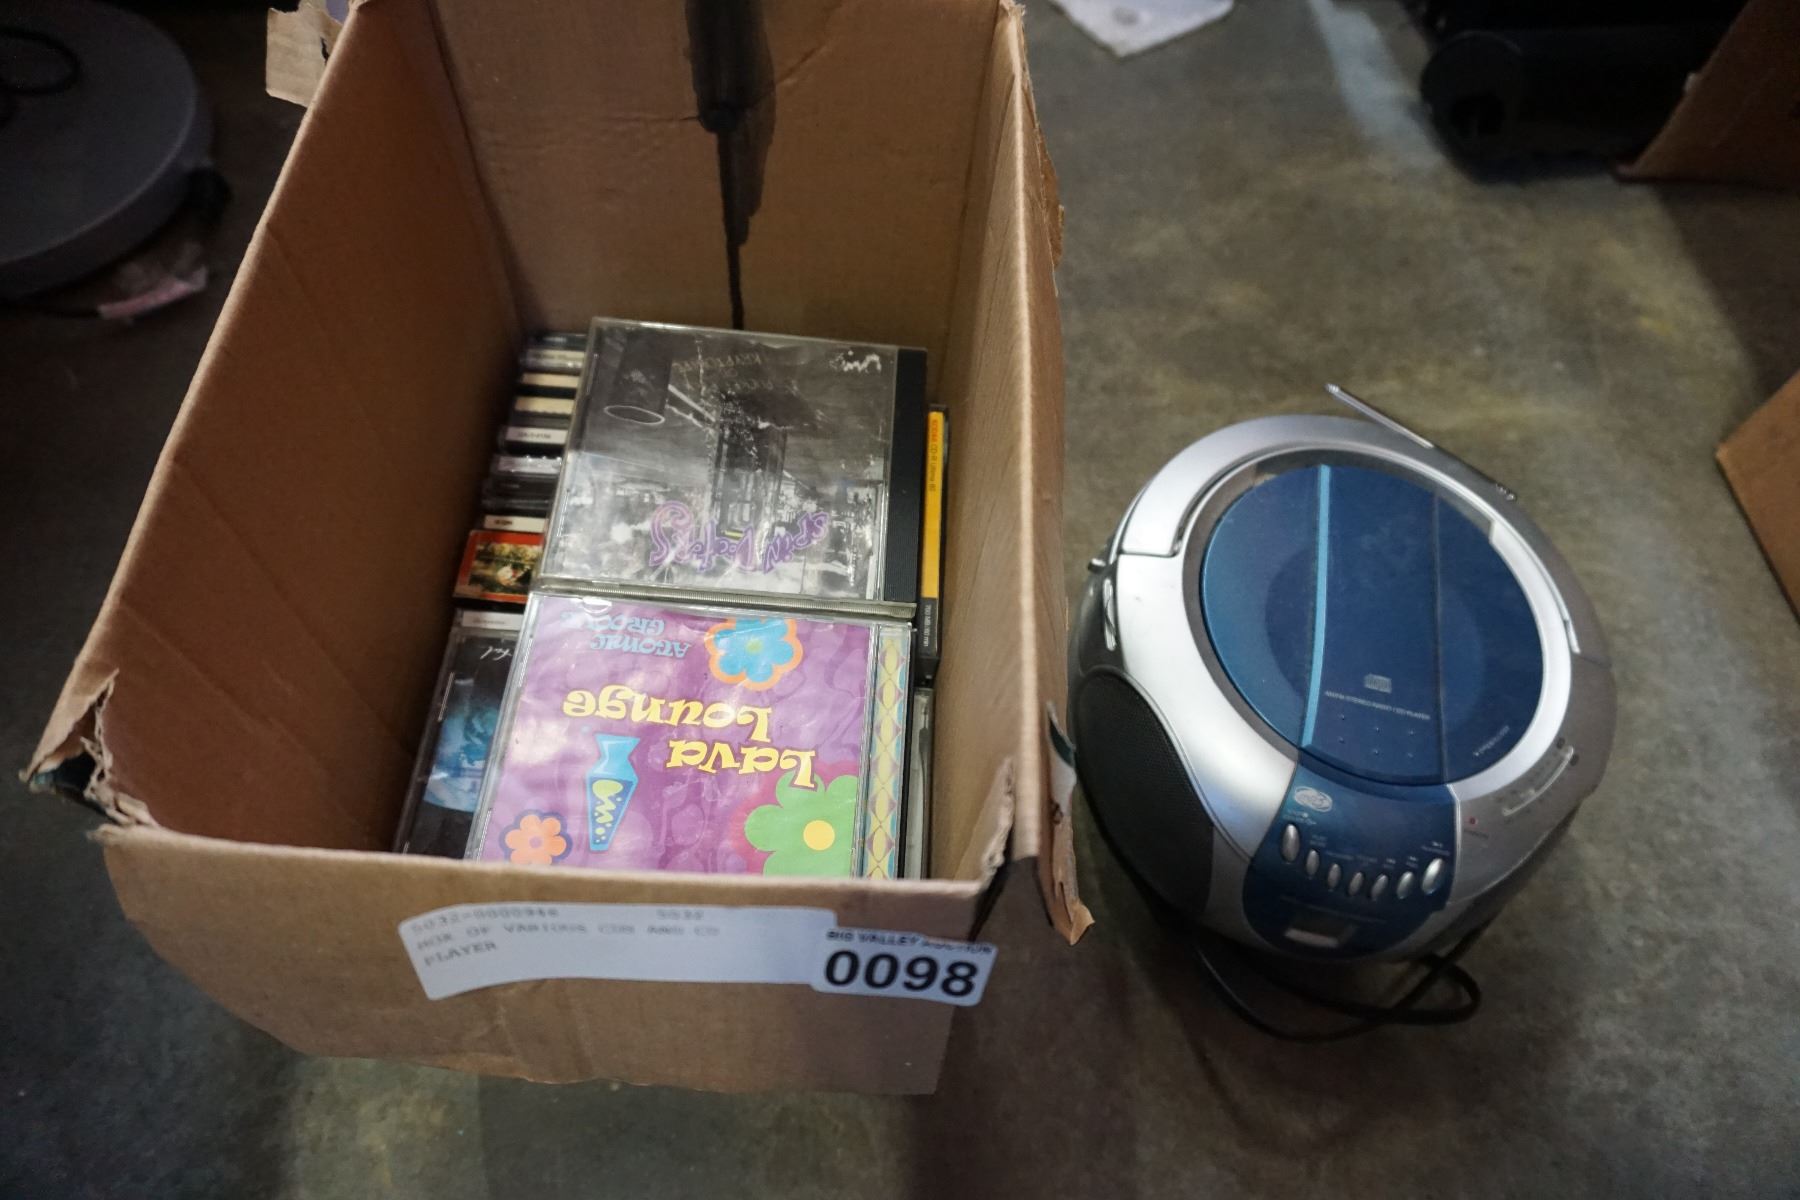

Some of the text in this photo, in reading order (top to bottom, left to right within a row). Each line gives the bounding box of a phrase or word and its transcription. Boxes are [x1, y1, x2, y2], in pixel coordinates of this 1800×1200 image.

[588, 633, 692, 659] ATOMIC
[562, 685, 773, 743] Lounge
[667, 739, 817, 791] Lava
[423, 940, 498, 966] PLAYER
[824, 949, 979, 997] 0098
